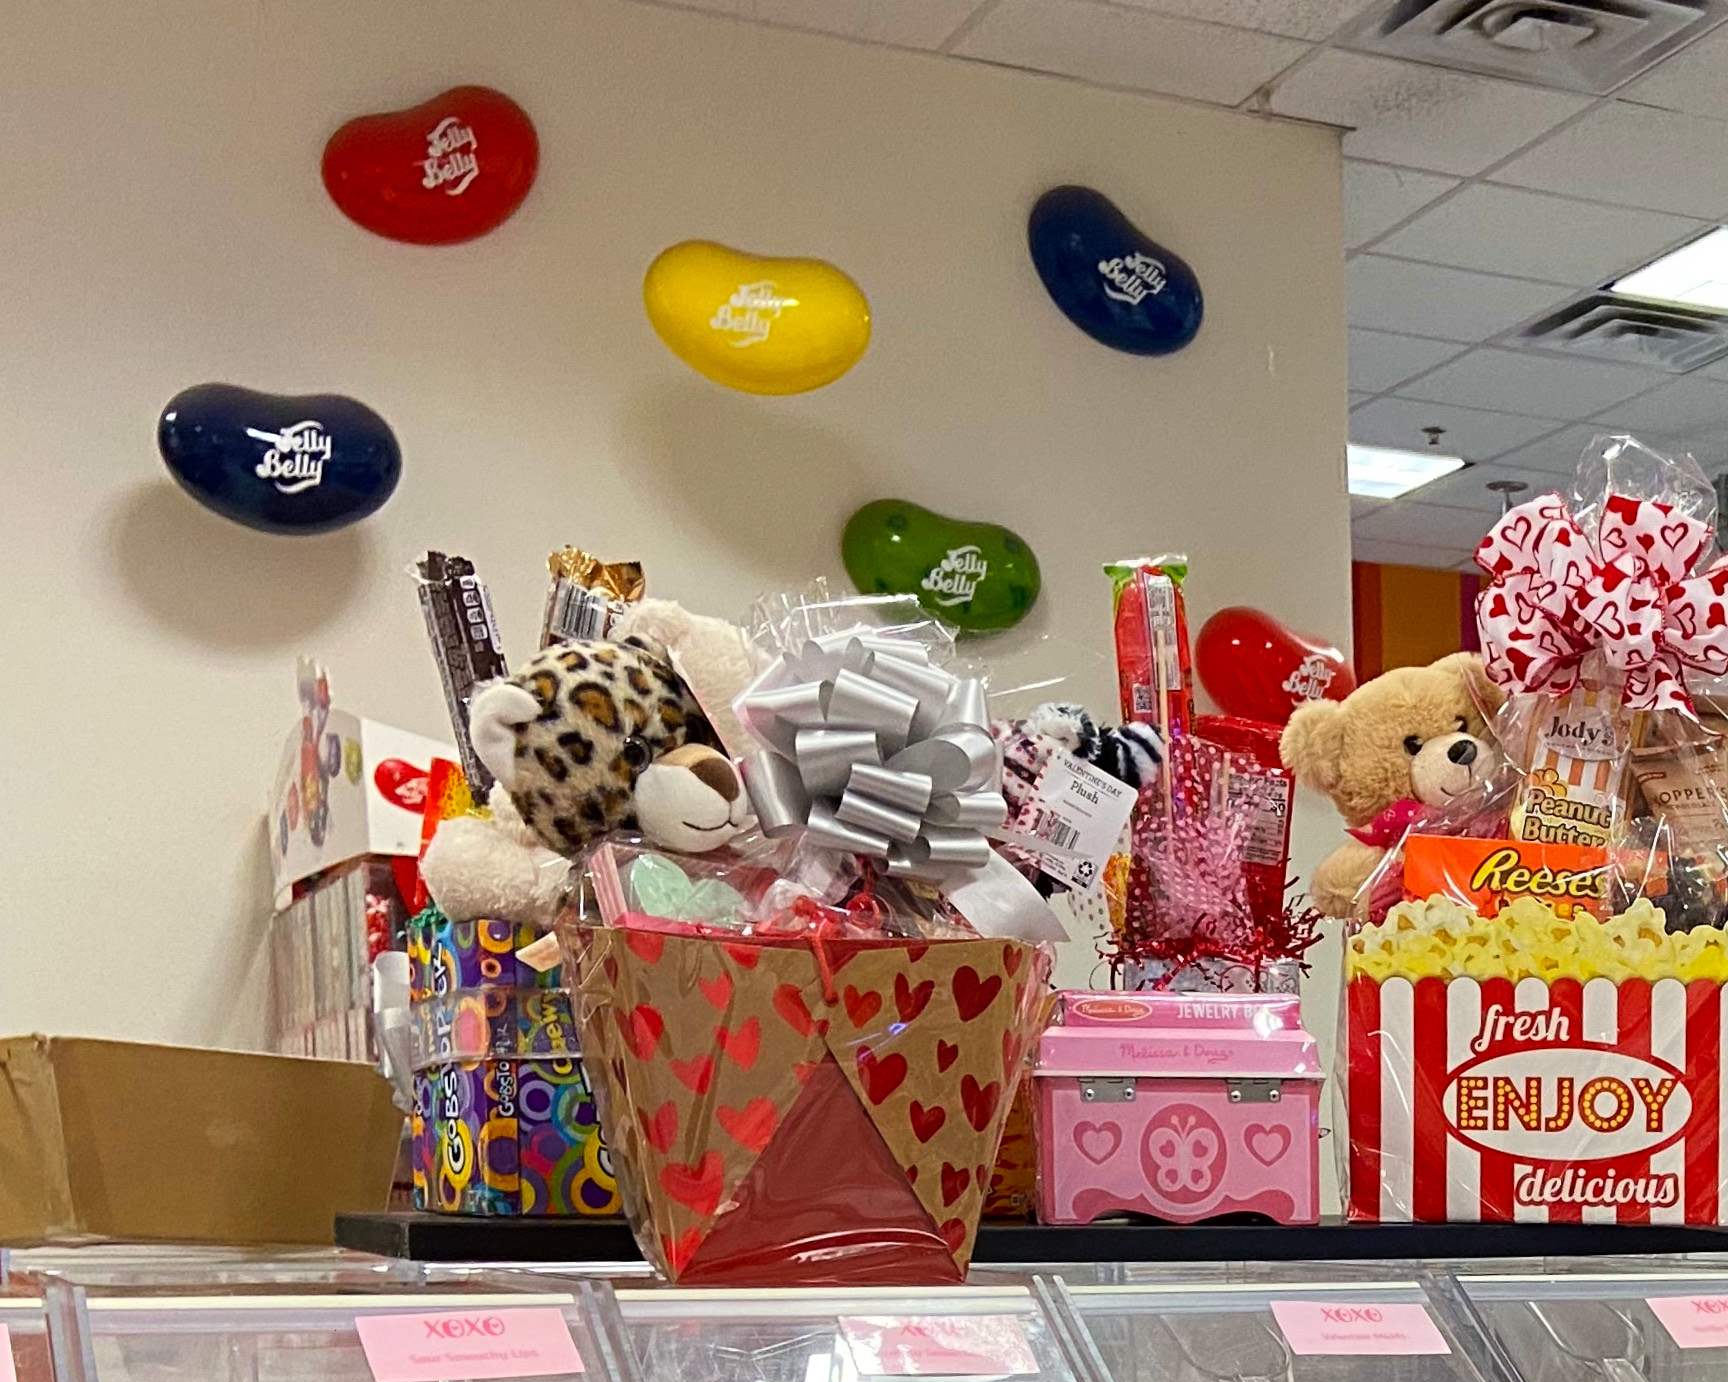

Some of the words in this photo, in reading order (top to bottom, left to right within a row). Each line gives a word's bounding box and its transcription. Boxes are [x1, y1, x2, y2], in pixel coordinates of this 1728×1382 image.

[426, 116, 477, 157] Jelly
[422, 152, 479, 196] Belly
[1098, 258, 1147, 305] Belly
[1125, 251, 1167, 294] Jelly
[729, 279, 783, 318] Jelly
[709, 304, 771, 348] Belly
[275, 420, 332, 461] Jelly
[255, 449, 323, 494] Belly
[941, 545, 988, 581] Jelly
[921, 567, 977, 607] Belly
[1282, 671, 1326, 706] Belly
[1299, 654, 1332, 689] Jelly
[1544, 716, 1615, 745] Jody's
[1064, 758, 1108, 791] VALENTINE'S
[1106, 784, 1123, 798] DAY
[1070, 780, 1099, 804] Plush
[1525, 789, 1612, 829] Peanut
[1522, 816, 1606, 848] Butter
[1177, 1003, 1237, 1019] JEWELRY
[1473, 1003, 1570, 1052] fresh
[1456, 1076, 1679, 1133] ENJOY
[1518, 1167, 1678, 1204] delicious
[408, 1352, 441, 1365] Sour
[511, 1347, 539, 1362] Lips
